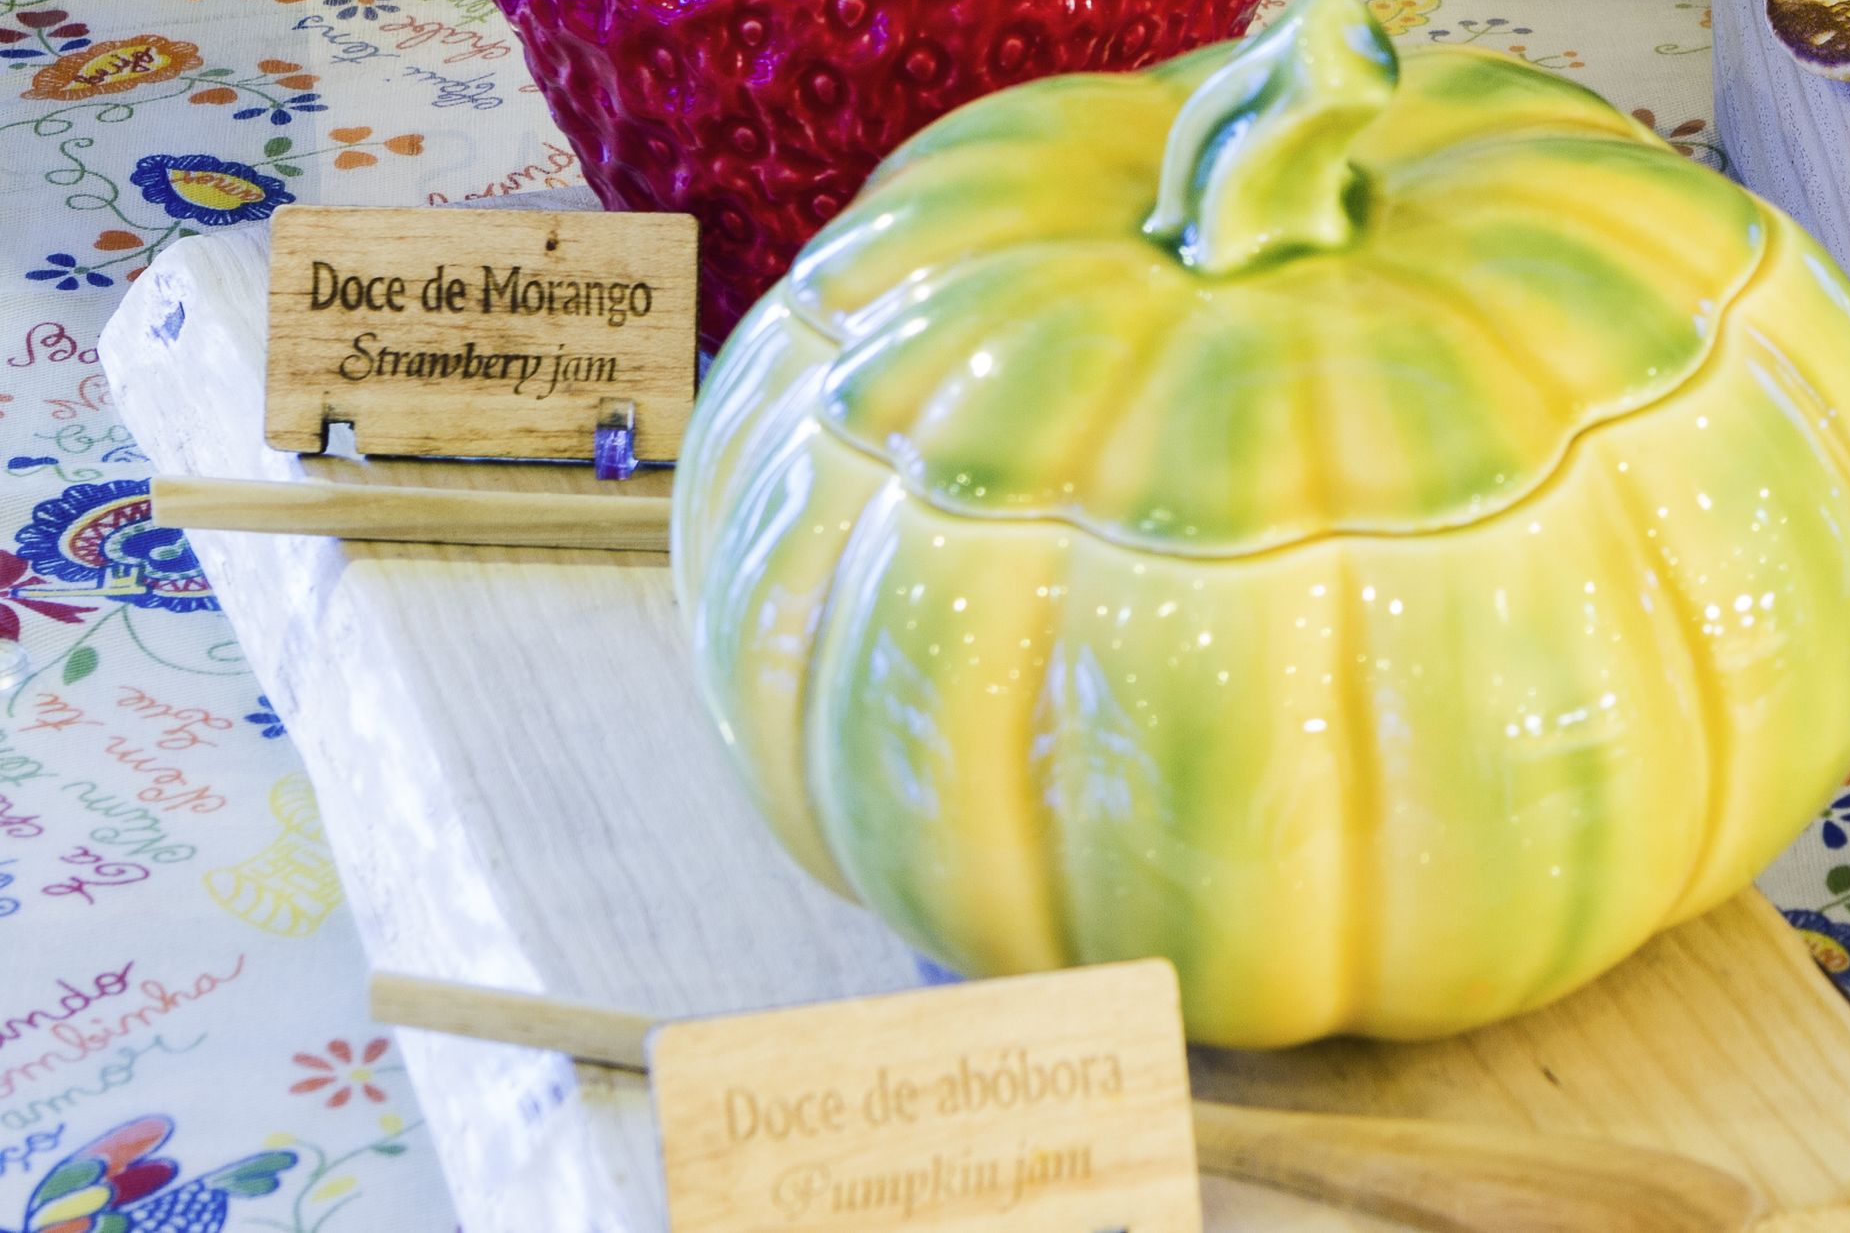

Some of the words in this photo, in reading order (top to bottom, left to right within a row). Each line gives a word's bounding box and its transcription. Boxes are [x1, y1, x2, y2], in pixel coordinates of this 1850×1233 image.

[310, 260, 406, 312] Doce
[421, 264, 467, 313] de
[481, 265, 653, 328] Morango
[536, 343, 618, 401] jam
[723, 1083, 850, 1144] Doce
[860, 1066, 921, 1129] de
[935, 1045, 1125, 1118] abóbora
[770, 1146, 999, 1219] Pumpkin
[1000, 1139, 1095, 1214] jam
